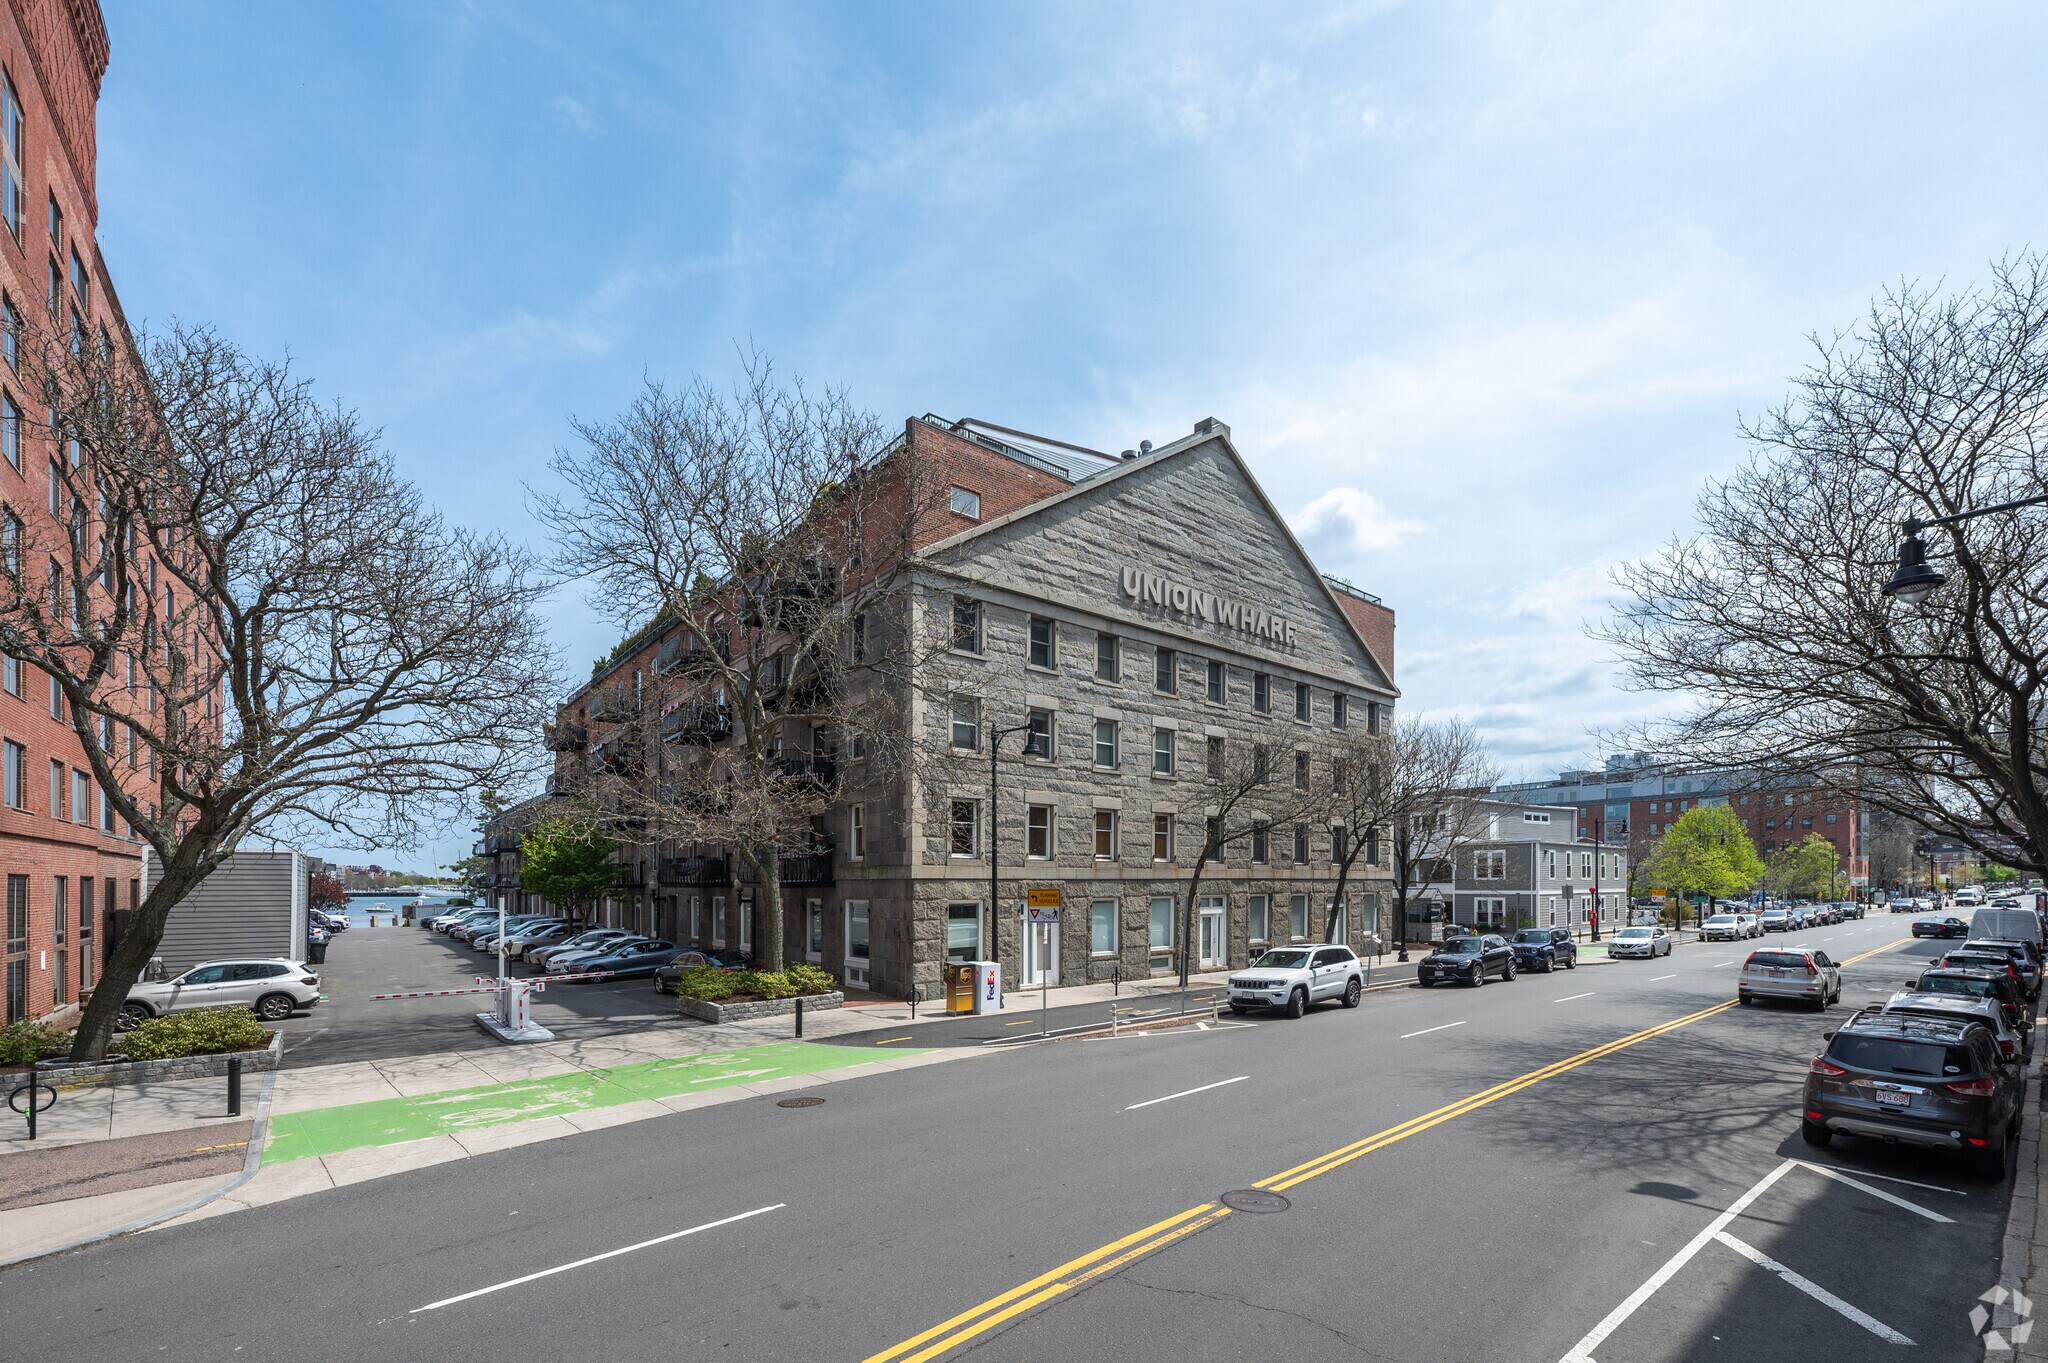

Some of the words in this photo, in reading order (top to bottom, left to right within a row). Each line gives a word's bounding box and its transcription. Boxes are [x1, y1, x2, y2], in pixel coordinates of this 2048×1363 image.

[1122, 566, 1208, 618] UNION
[1215, 597, 1297, 646] WHARF
[987, 970, 995, 1000] FedEx
[1877, 1092, 1892, 1101] 6VS
